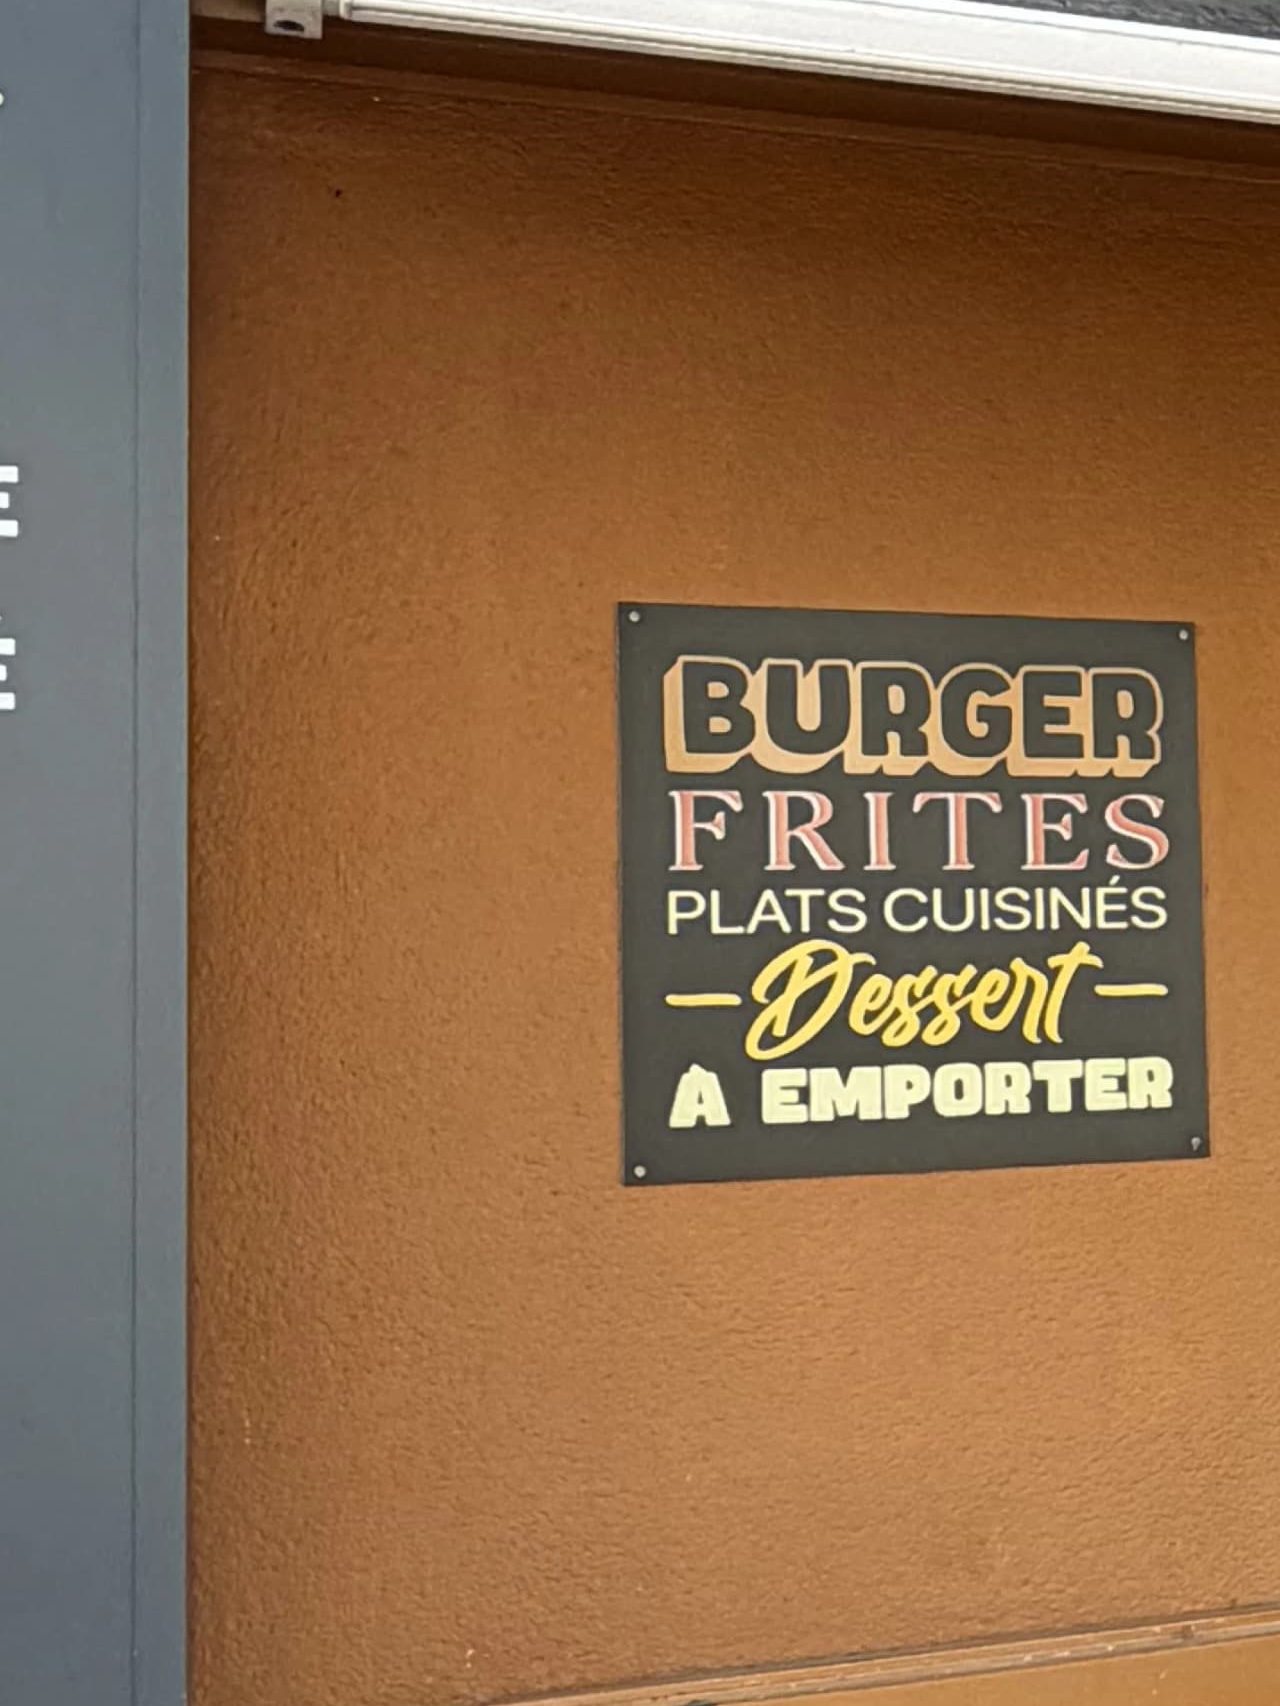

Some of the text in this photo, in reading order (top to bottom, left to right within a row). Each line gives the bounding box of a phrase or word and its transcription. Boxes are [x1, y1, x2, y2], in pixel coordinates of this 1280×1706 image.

[663, 655, 1163, 777] BURGER
[668, 789, 1170, 872] FRITES
[667, 876, 1168, 936] PLATS CUISINÉS
[744, 939, 1104, 1061] Dessert
[761, 1057, 1174, 1124] EMPORTER
